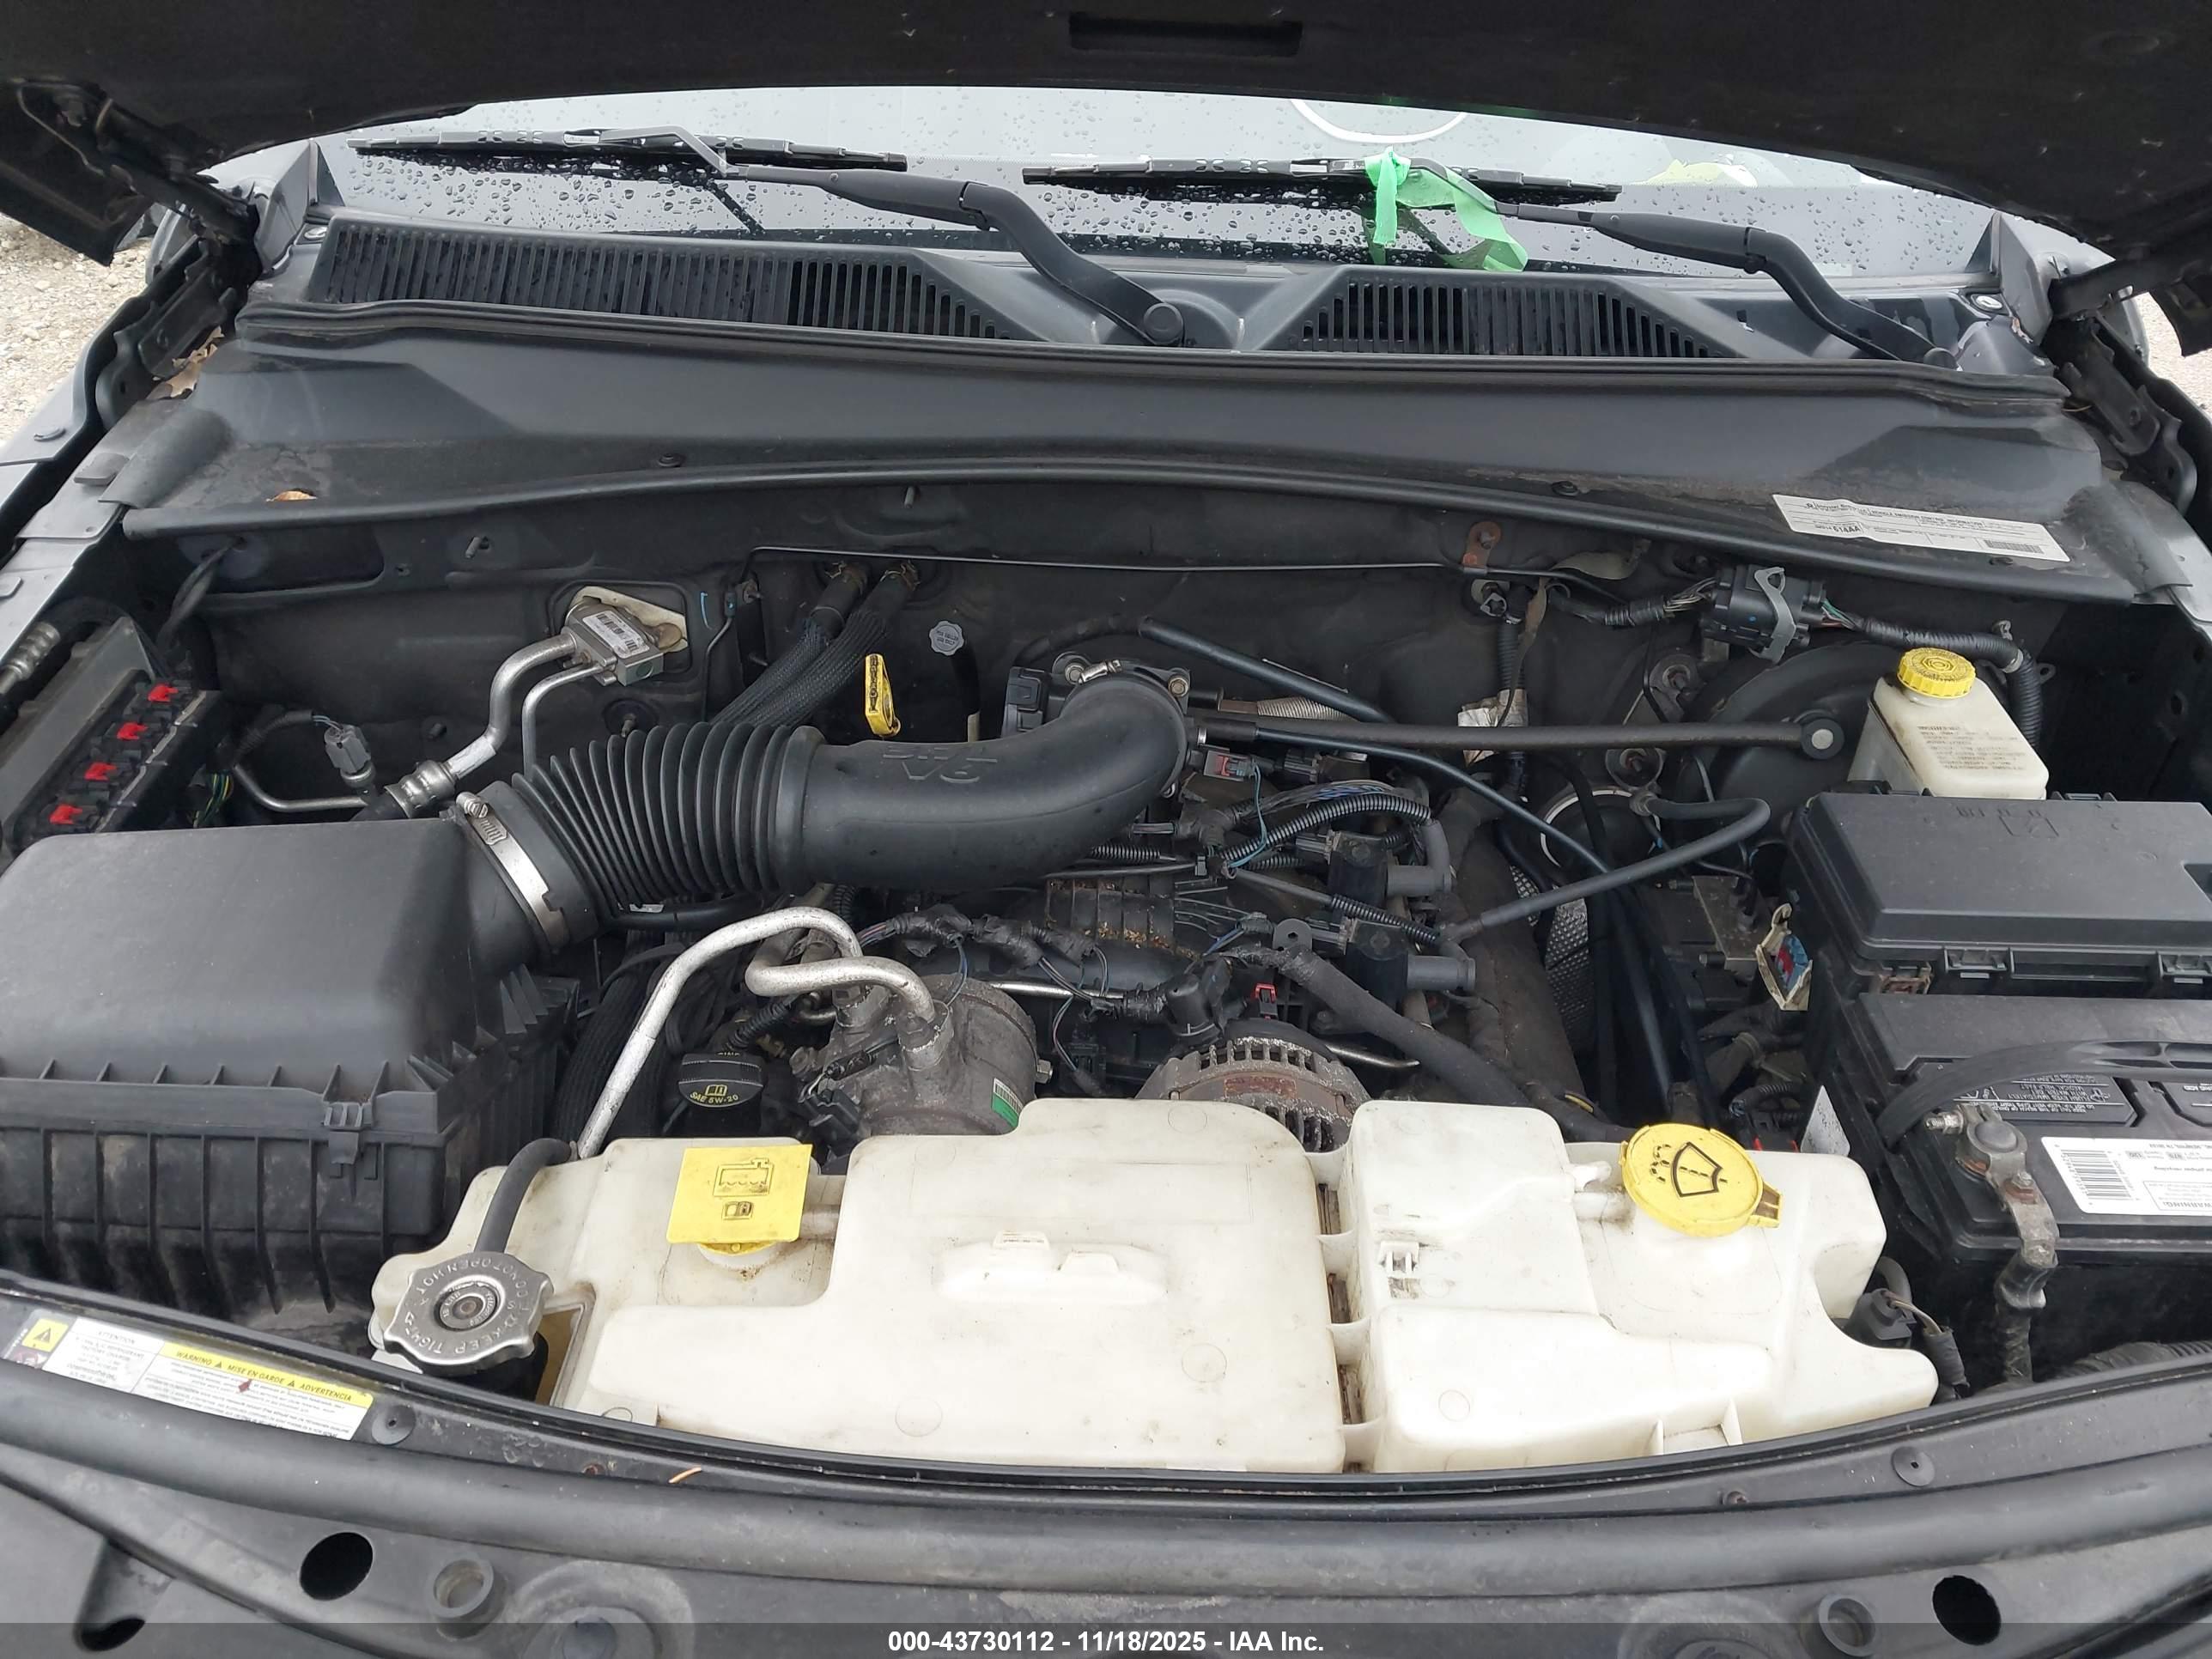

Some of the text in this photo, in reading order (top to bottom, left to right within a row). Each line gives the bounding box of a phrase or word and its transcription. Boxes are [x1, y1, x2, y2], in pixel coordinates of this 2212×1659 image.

[690, 1091, 738, 1103] SAE 5W-20
[176, 1351, 352, 1401] WARNING MISE EN GARDE ADVERTENCIA
